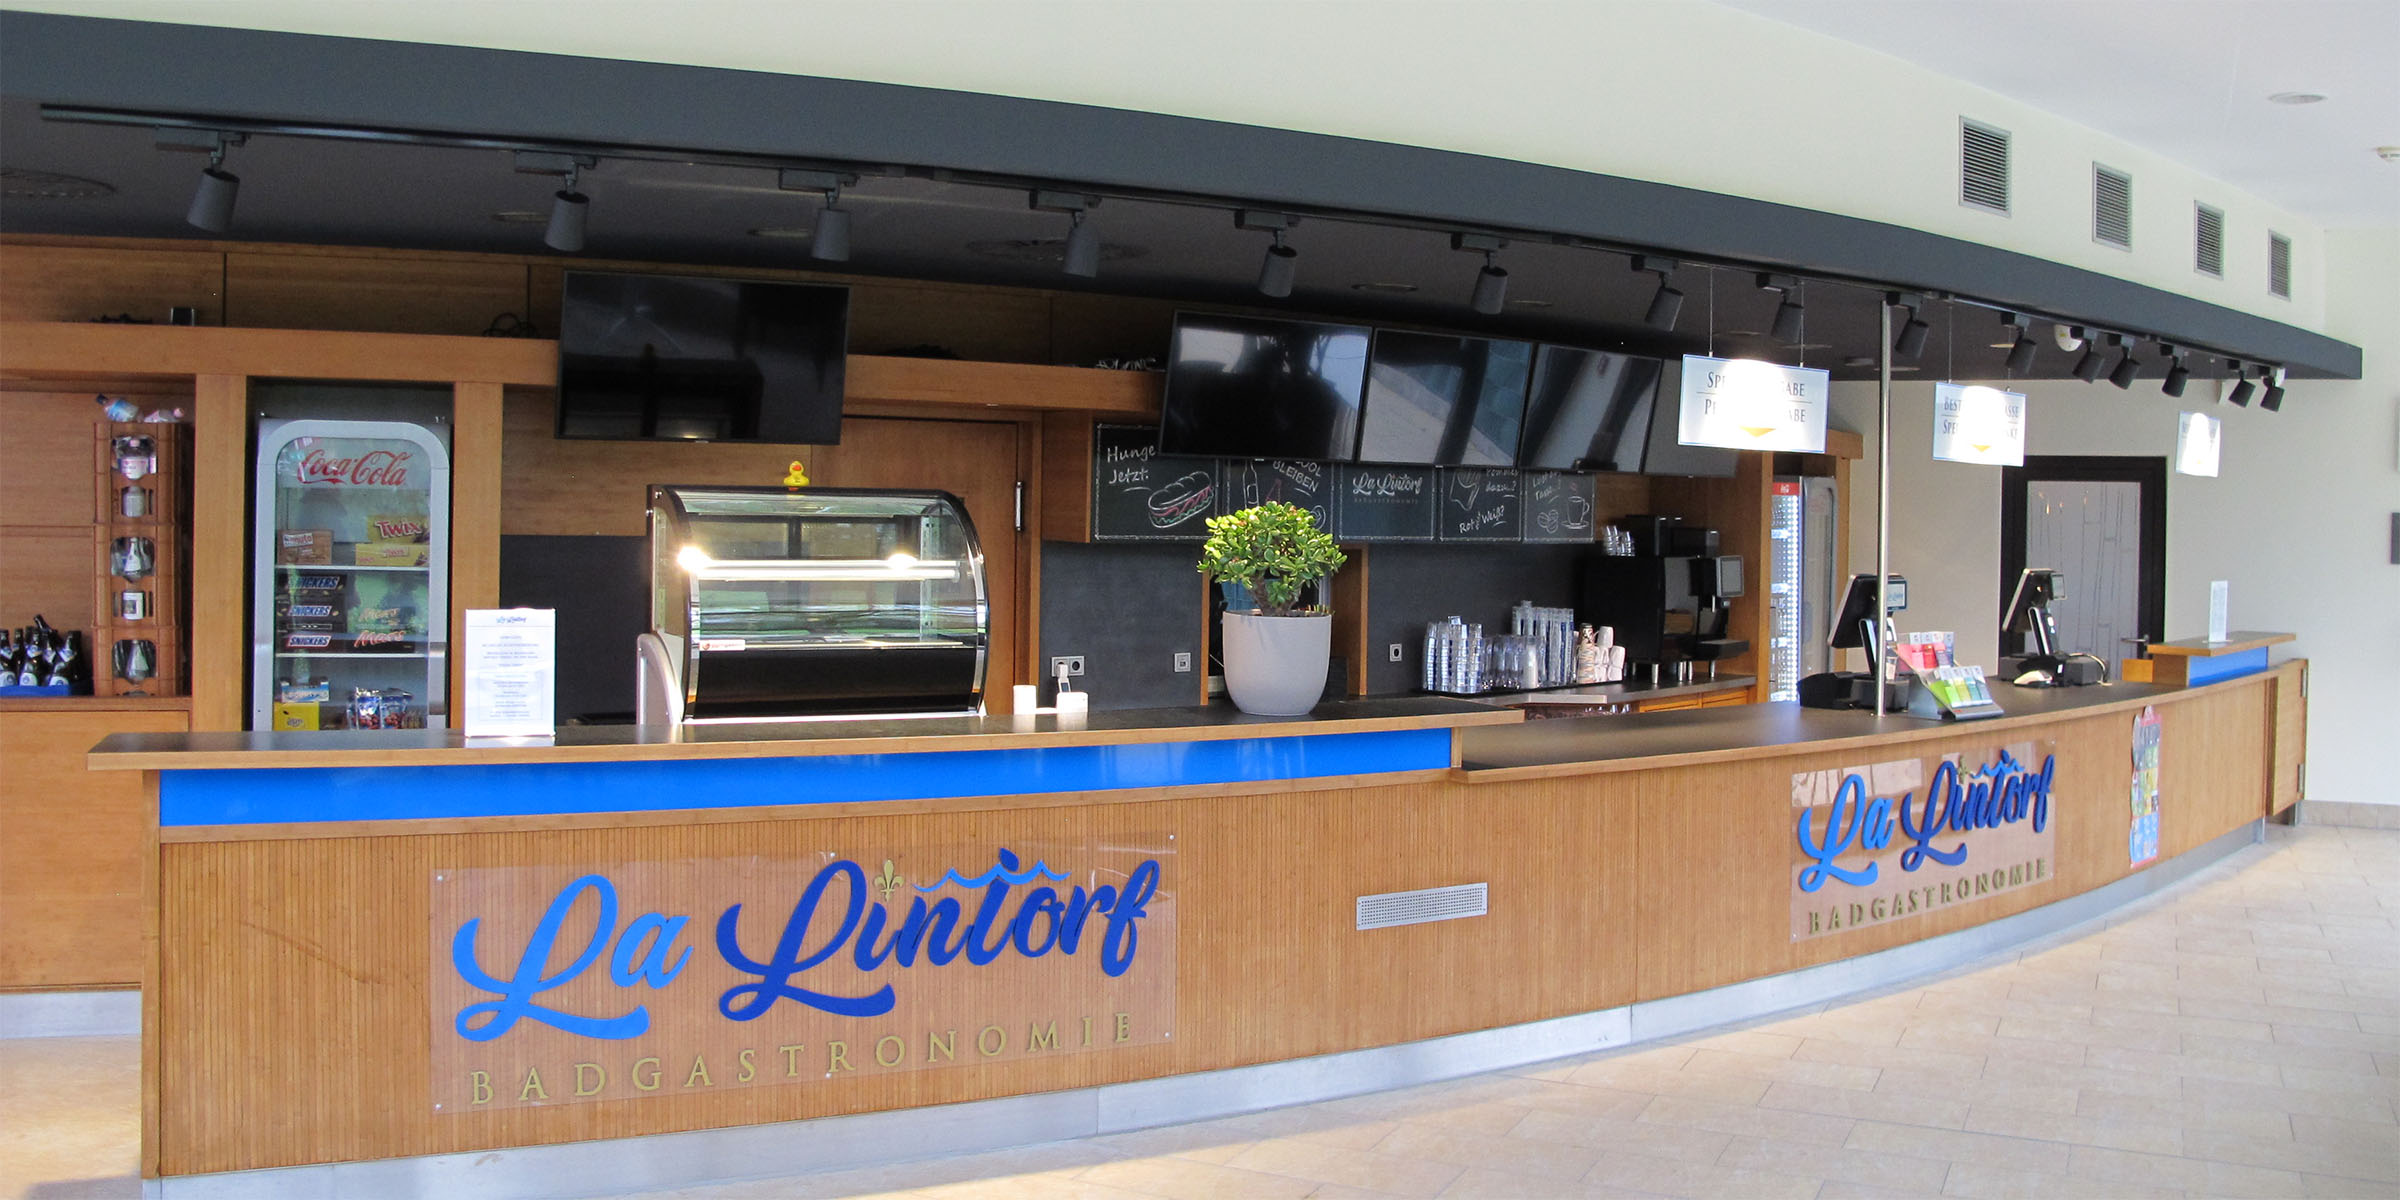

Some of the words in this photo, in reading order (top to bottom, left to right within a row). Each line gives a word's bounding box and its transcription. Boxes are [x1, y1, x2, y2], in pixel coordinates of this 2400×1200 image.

[1106, 445, 1156, 463] Hunge
[297, 449, 413, 486] Coca-Cola
[1272, 460, 1319, 493] BLEIBEN
[375, 519, 423, 538] Twix
[290, 577, 338, 588] NICKERS
[291, 606, 330, 616] SNICKERS
[290, 636, 330, 646] SNICKERS
[354, 631, 406, 648] Mars
[1798, 774, 1895, 893] La
[1901, 750, 2054, 872] Lintorf
[1809, 858, 2046, 934] BADGASTRONOMIE
[452, 874, 692, 1042] La
[716, 848, 1161, 1022] Lintorf
[470, 1012, 1133, 1106] BADGASTRONOMIE
